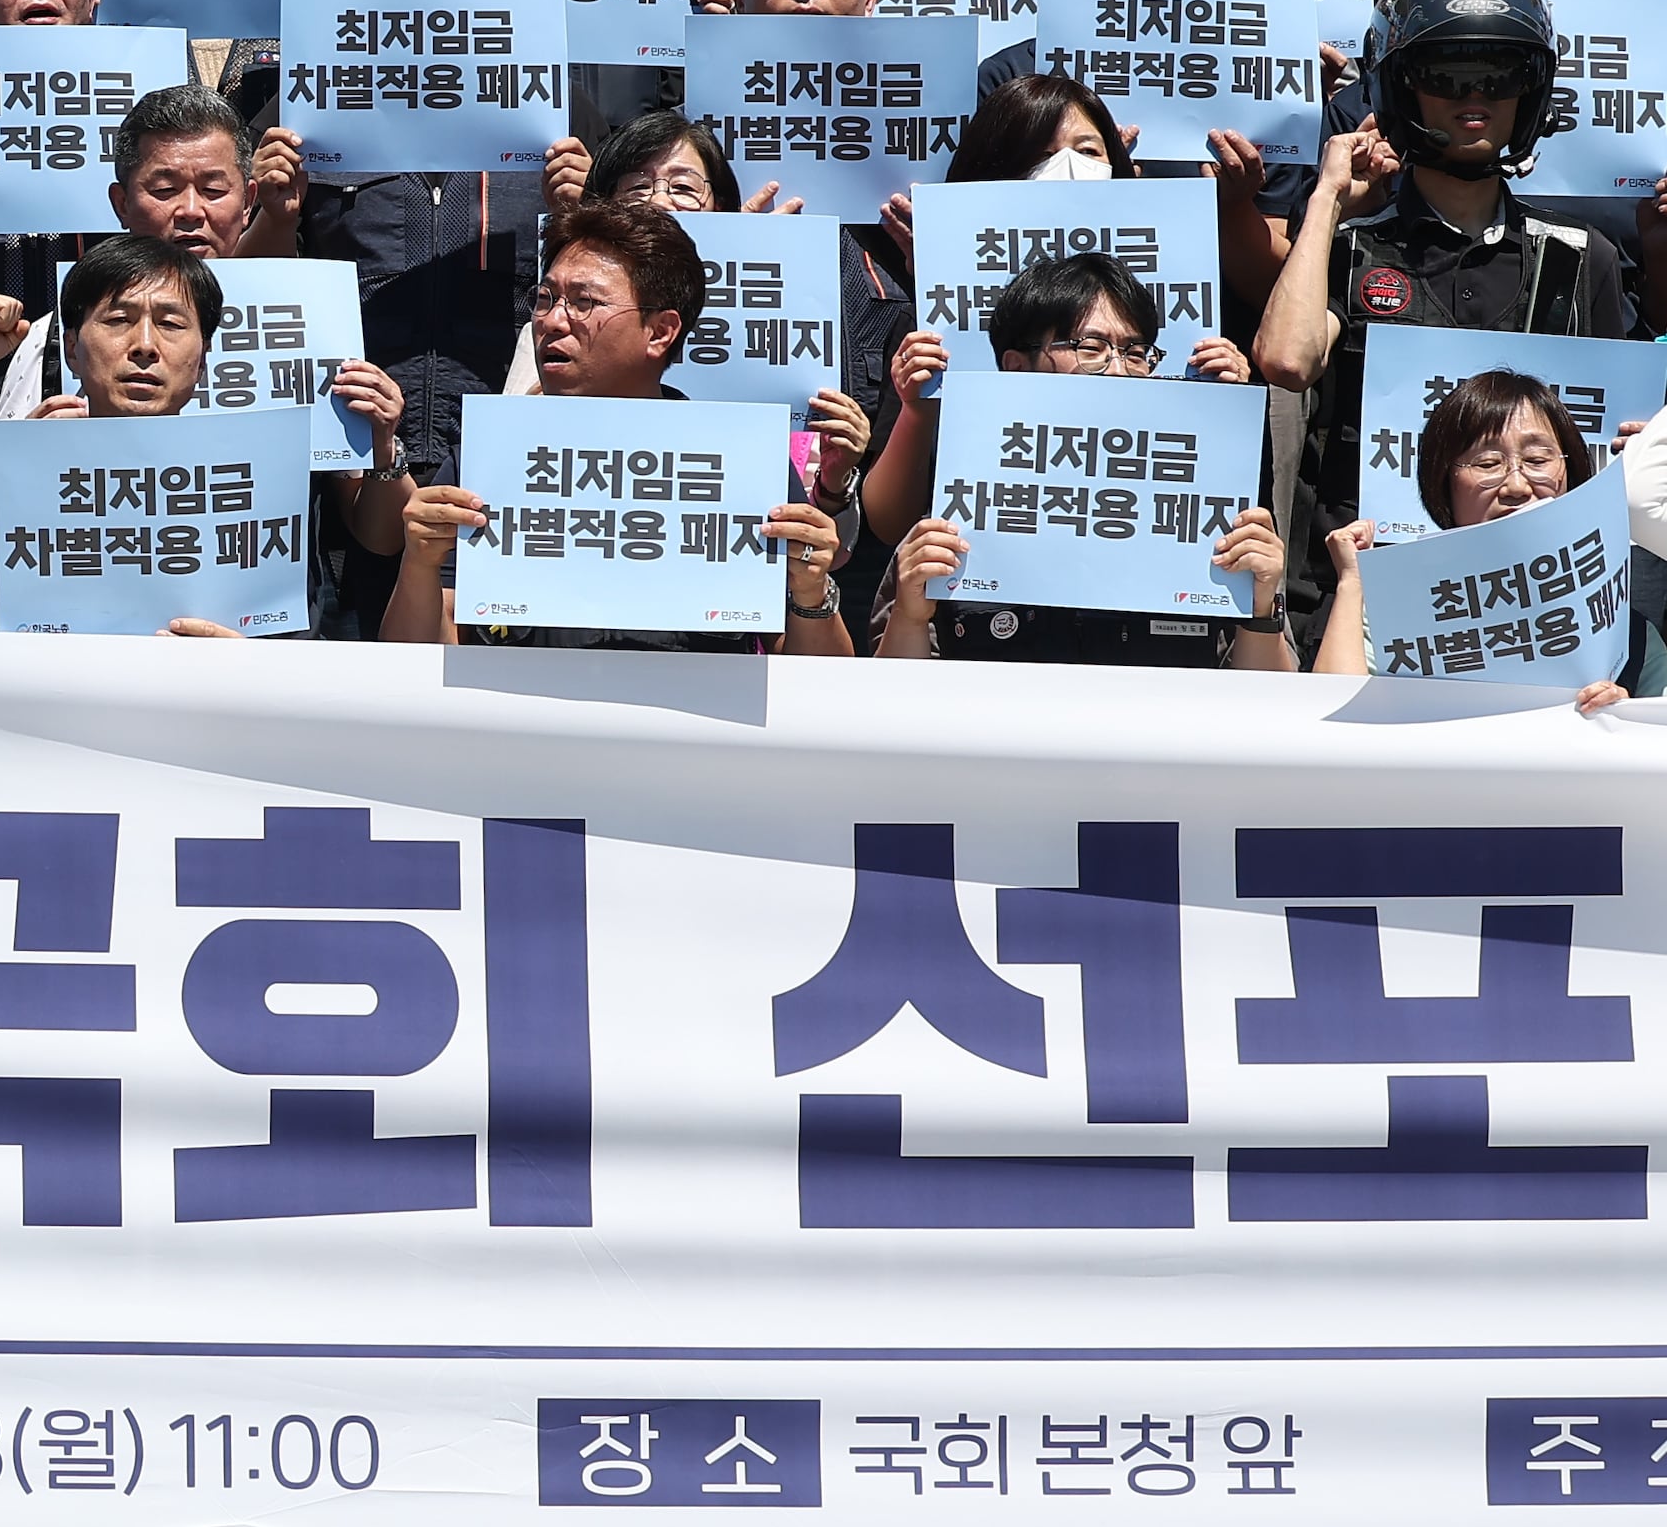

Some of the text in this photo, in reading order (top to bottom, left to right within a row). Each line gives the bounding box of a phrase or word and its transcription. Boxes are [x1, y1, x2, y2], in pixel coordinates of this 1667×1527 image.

[336, 10, 513, 55] 최저임금
[287, 63, 562, 110] 차별적용 폐지
[525, 446, 724, 502] 최저임금
[1000, 422, 1198, 483] 최저임금
[59, 463, 254, 517] 최저임금
[941, 479, 1250, 544] 차별적용 폐지
[4, 514, 301, 576] 차별적용 폐지
[485, 507, 779, 563] 차별적용 폐지
[772, 822, 1648, 1228] 선포
[168, 1413, 379, 1491] 11:00
[578, 1414, 659, 1497] 장
[701, 1415, 783, 1495] 소
[848, 1412, 1009, 1497] 국회
[1035, 1414, 1198, 1497] 본청
[1222, 1414, 1302, 1497] 앞
